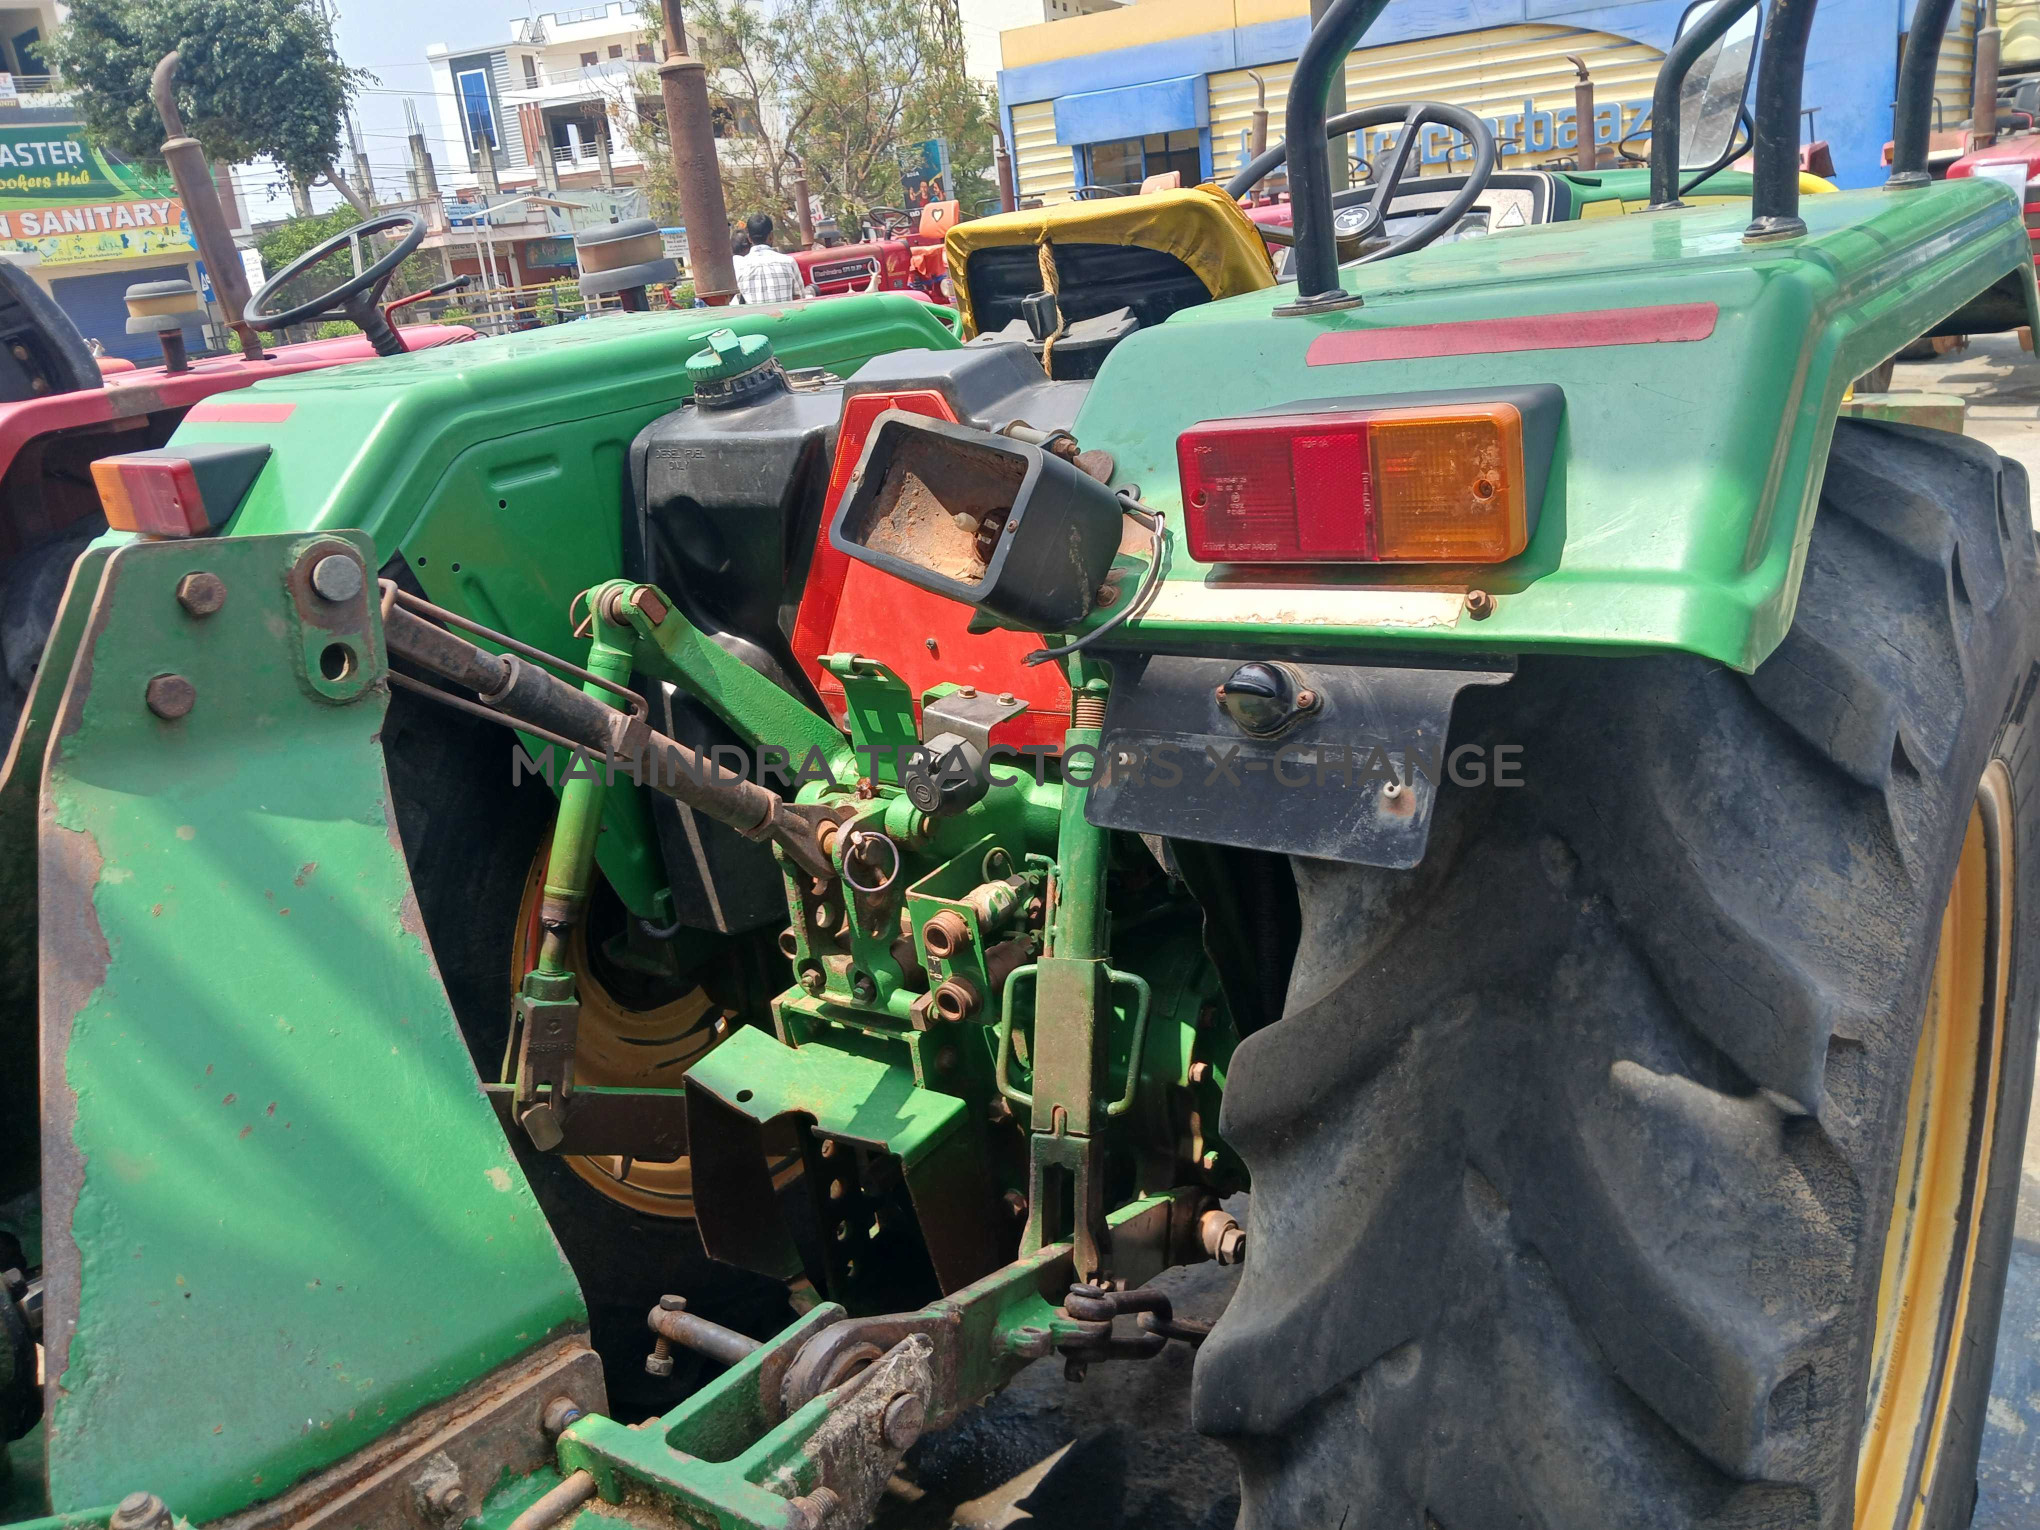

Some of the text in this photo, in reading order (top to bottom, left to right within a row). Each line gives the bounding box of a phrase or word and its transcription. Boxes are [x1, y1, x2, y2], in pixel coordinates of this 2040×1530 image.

[1352, 98, 1654, 172] rctrbaaz
[0, 140, 84, 168] ASTER
[56, 169, 91, 187] Hub
[19, 201, 170, 236] SANITARY
[814, 267, 842, 277] Mahindra
